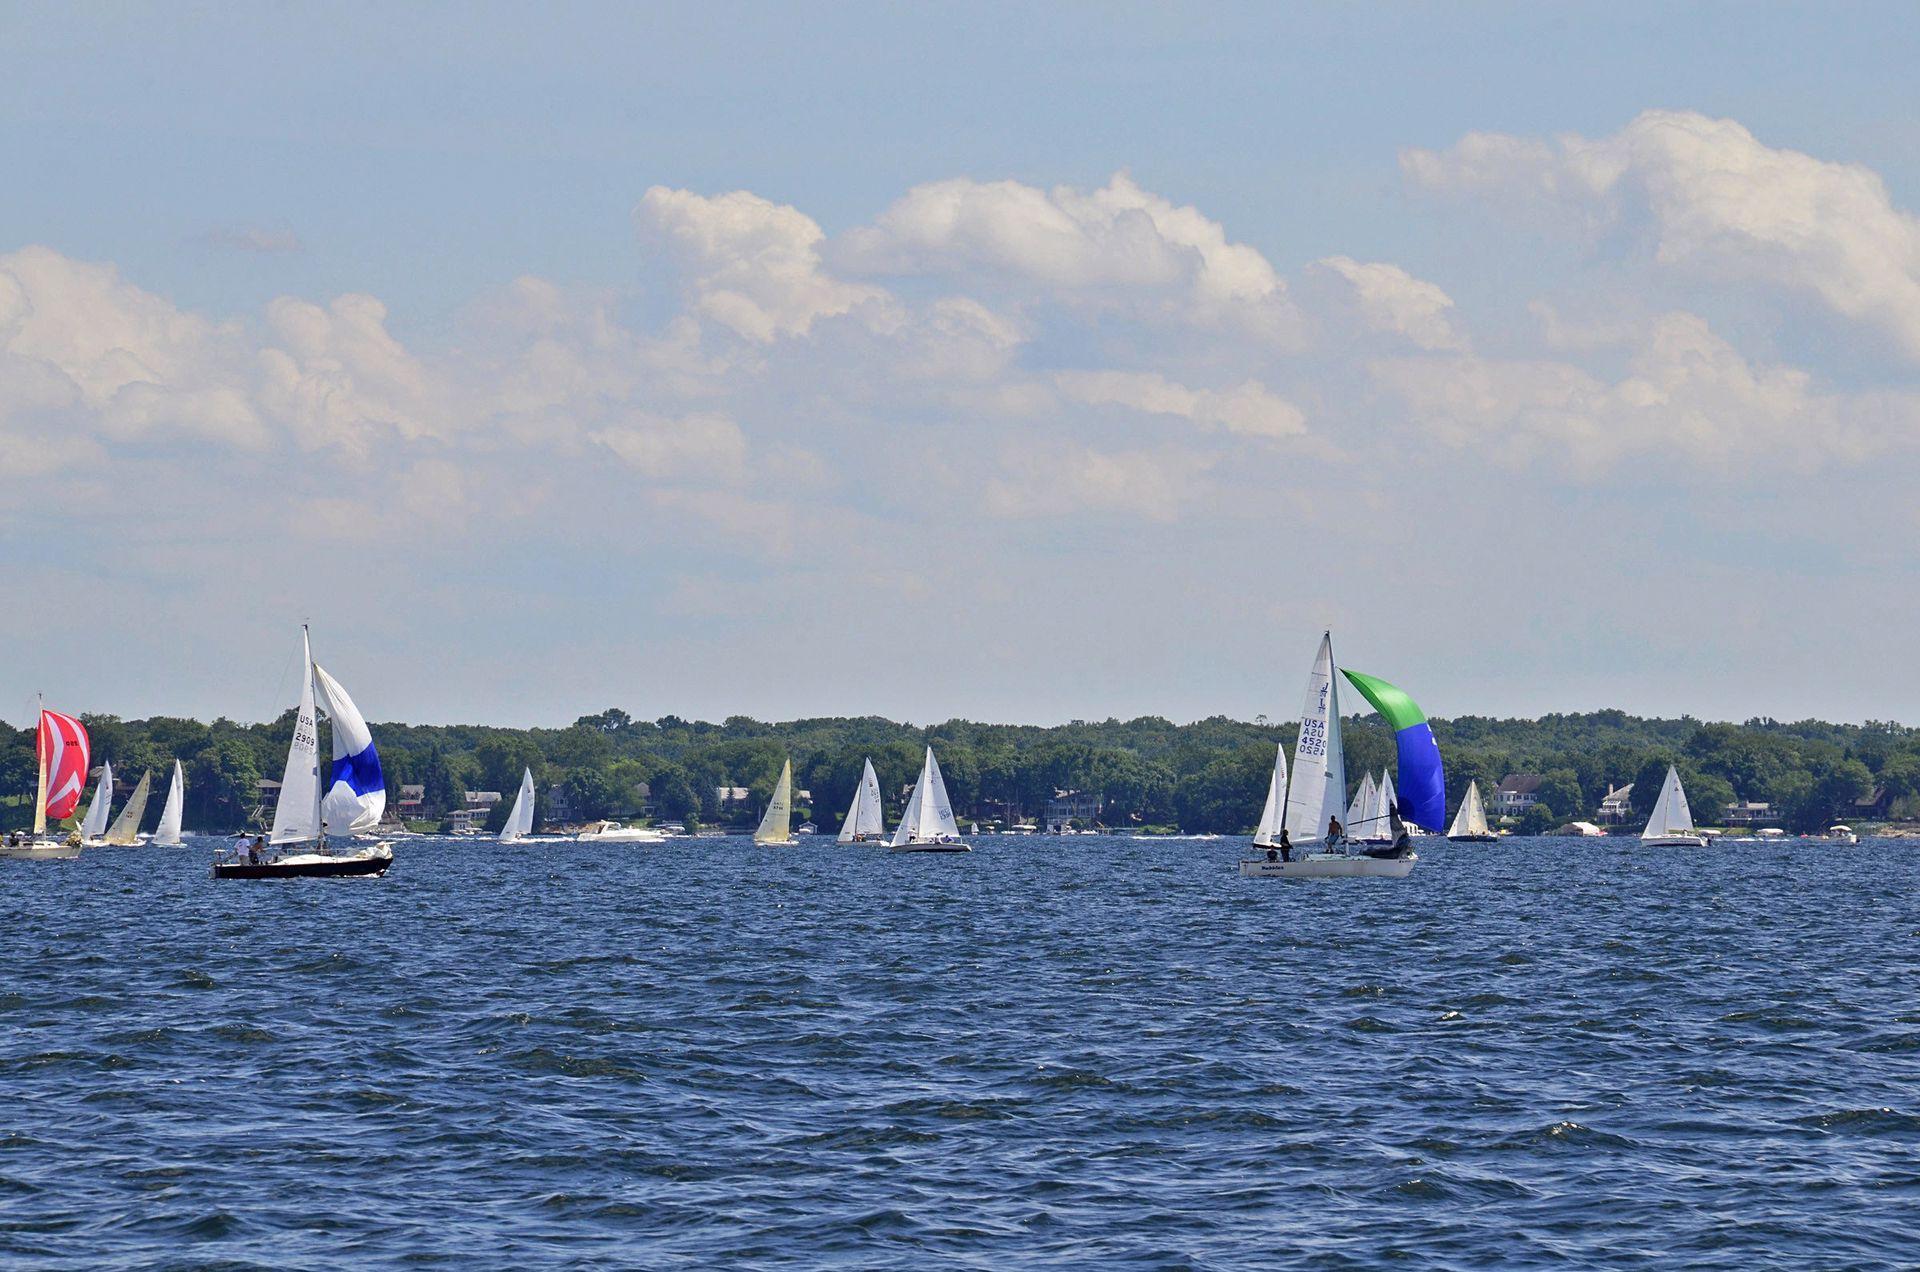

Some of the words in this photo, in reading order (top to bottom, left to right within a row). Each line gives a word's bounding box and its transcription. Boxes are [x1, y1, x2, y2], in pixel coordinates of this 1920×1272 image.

[300, 715, 313, 726] USA
[1304, 719, 1324, 729] USA
[296, 732, 314, 746] 2909
[1302, 737, 1326, 748] 4520
